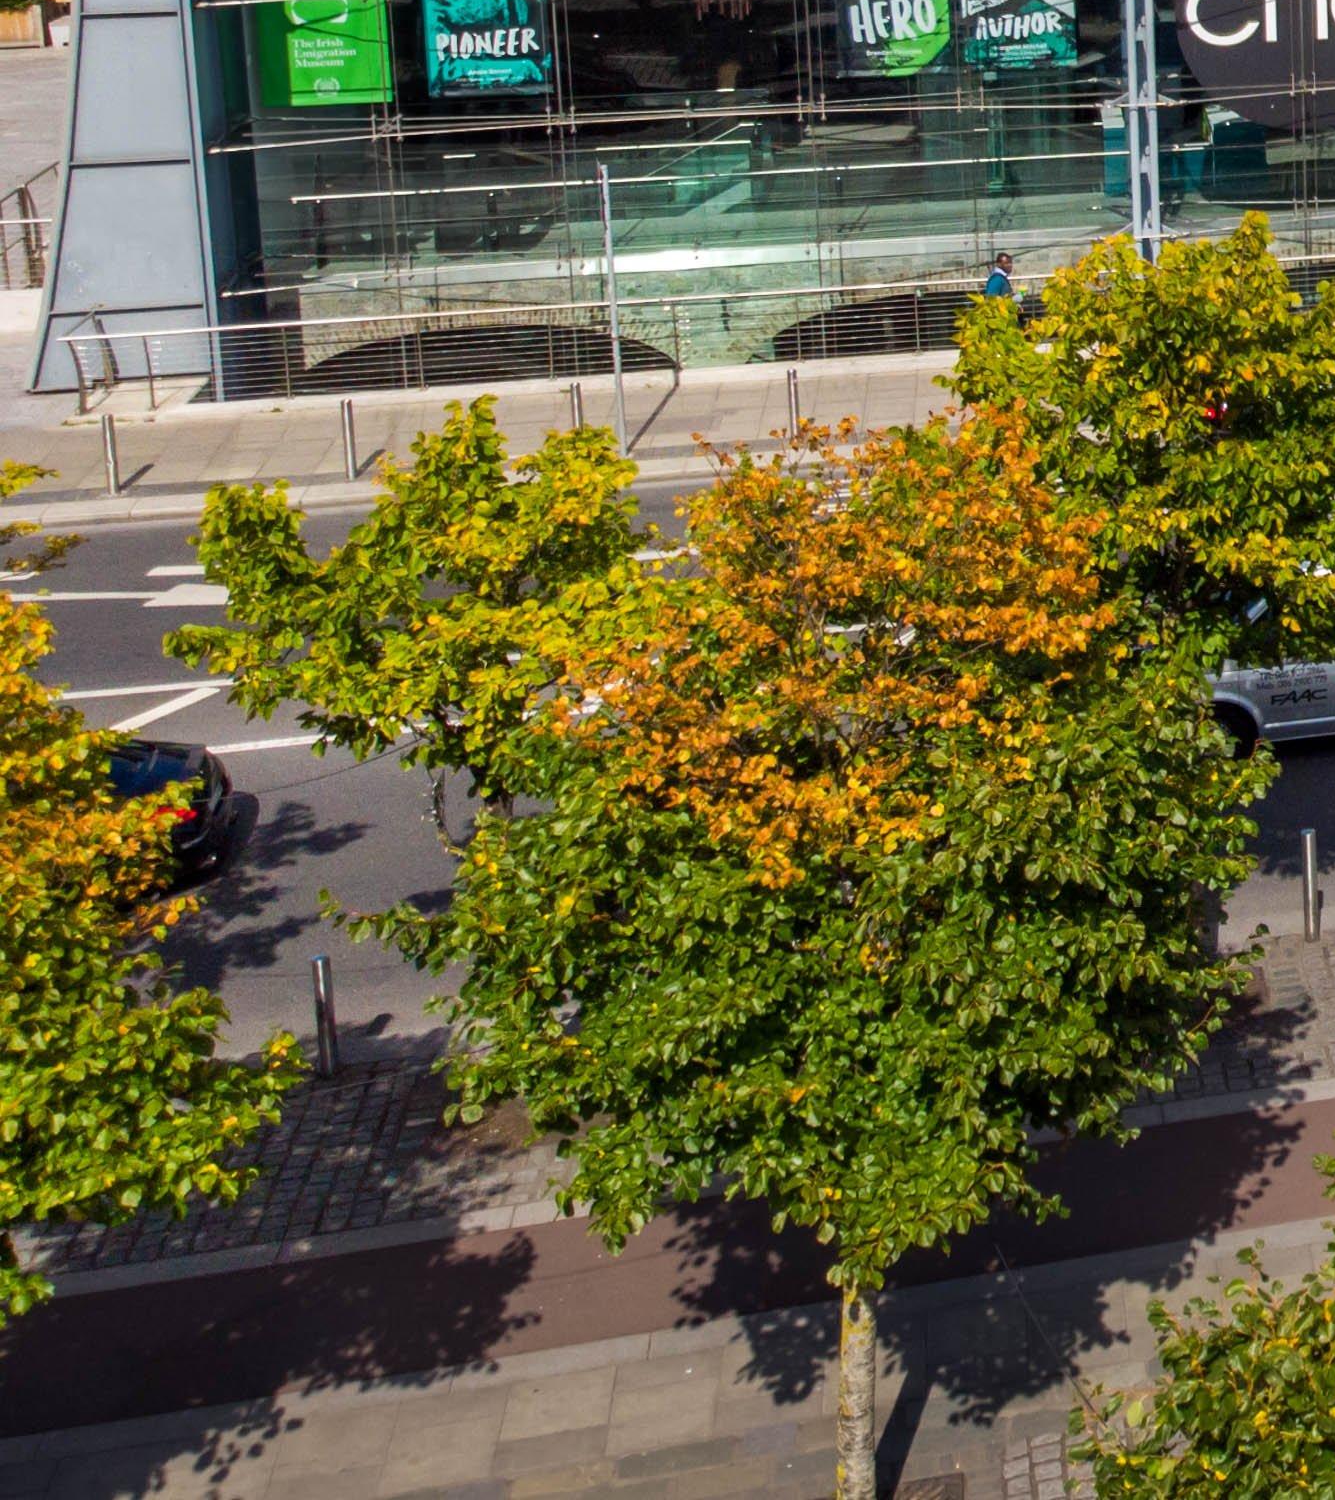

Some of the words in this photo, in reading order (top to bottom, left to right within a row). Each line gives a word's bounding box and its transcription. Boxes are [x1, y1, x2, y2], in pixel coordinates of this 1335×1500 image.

[976, 11, 1063, 40] AUTHOR
[294, 38, 315, 48] The
[316, 37, 344, 48] Irish
[436, 27, 540, 61] PIONEER
[294, 49, 357, 59] Emigration
[295, 59, 345, 68] Museum
[1270, 688, 1328, 705] FAAC
